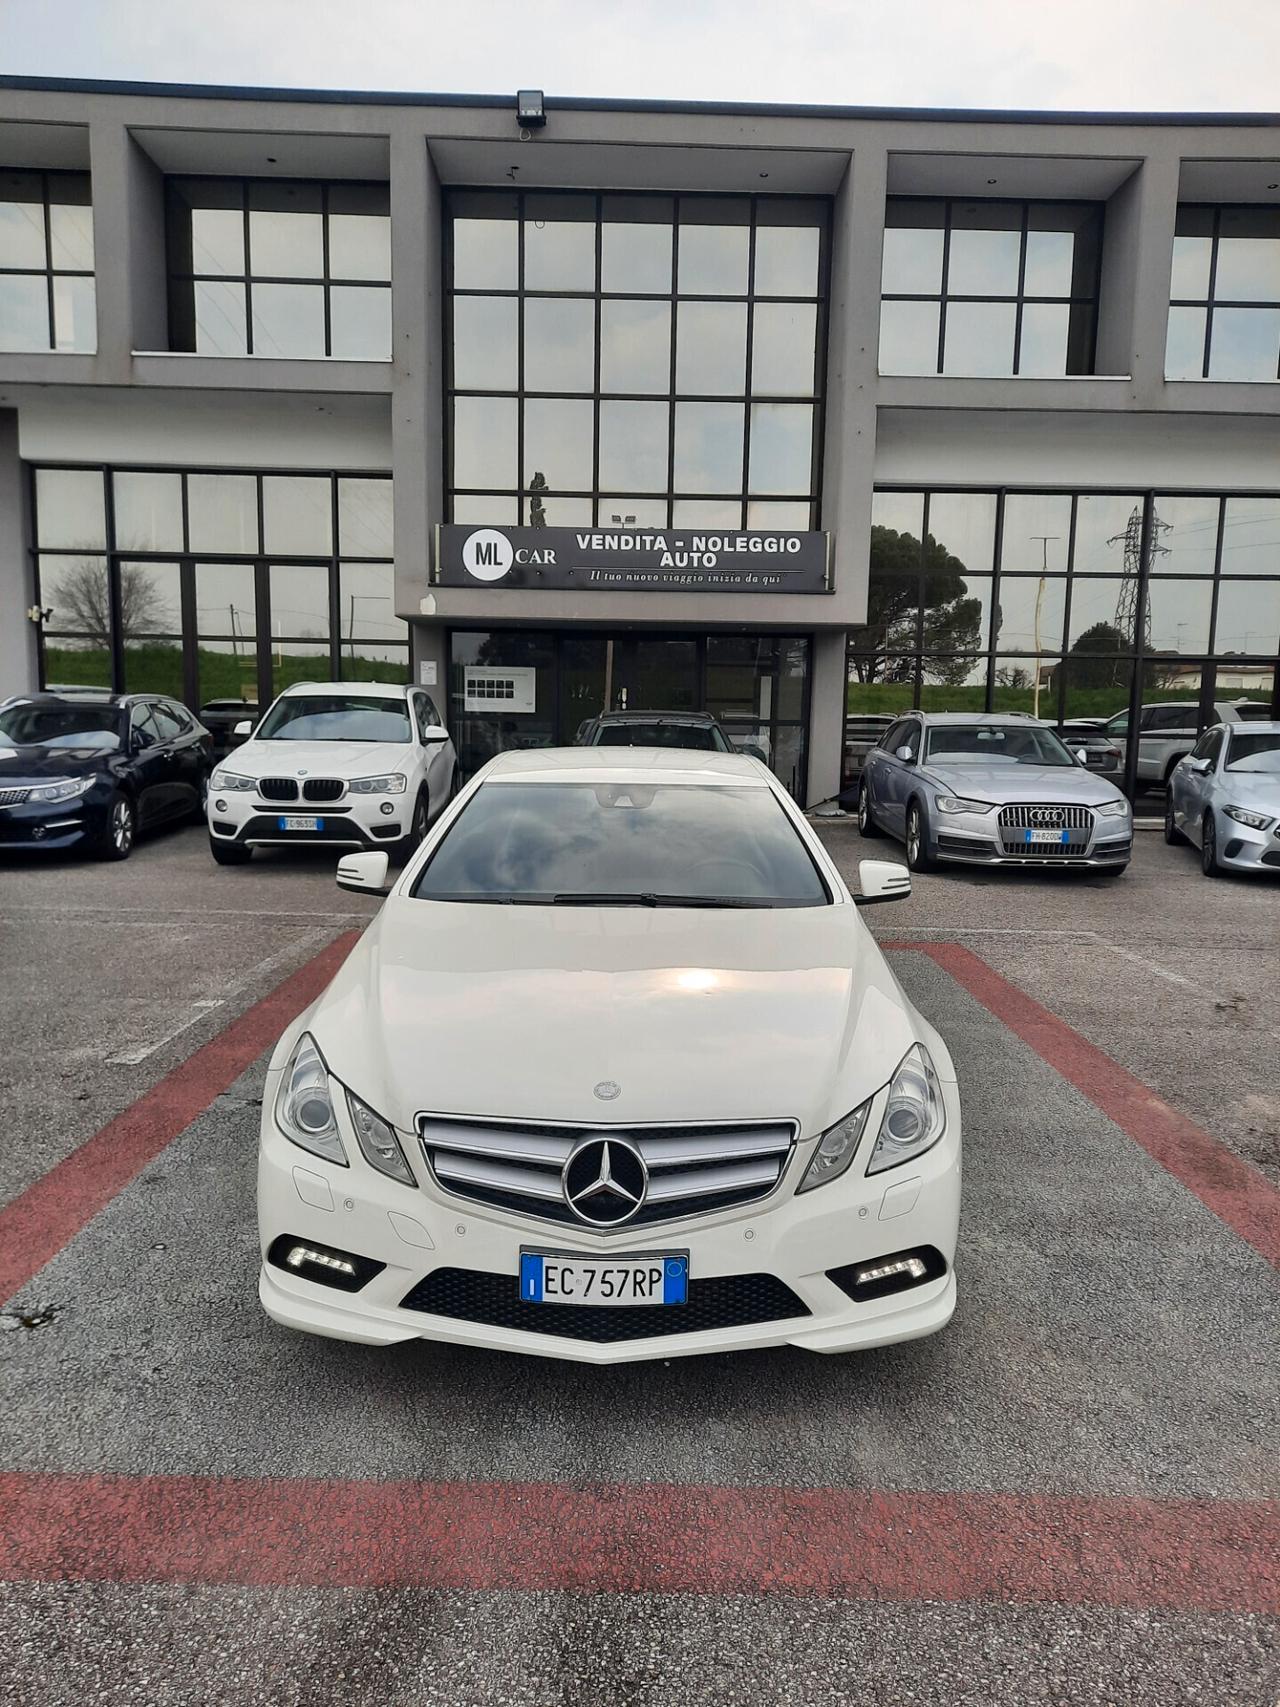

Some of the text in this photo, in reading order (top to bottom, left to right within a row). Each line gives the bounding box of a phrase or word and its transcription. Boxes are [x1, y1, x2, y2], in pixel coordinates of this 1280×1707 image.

[576, 534, 668, 550] VENDITA
[692, 536, 801, 553] NOLEGGIO
[475, 542, 557, 565] ML CAR
[660, 551, 717, 567] AUTO
[590, 570, 781, 586] Il tuo nuovo viaggio inizia da qui
